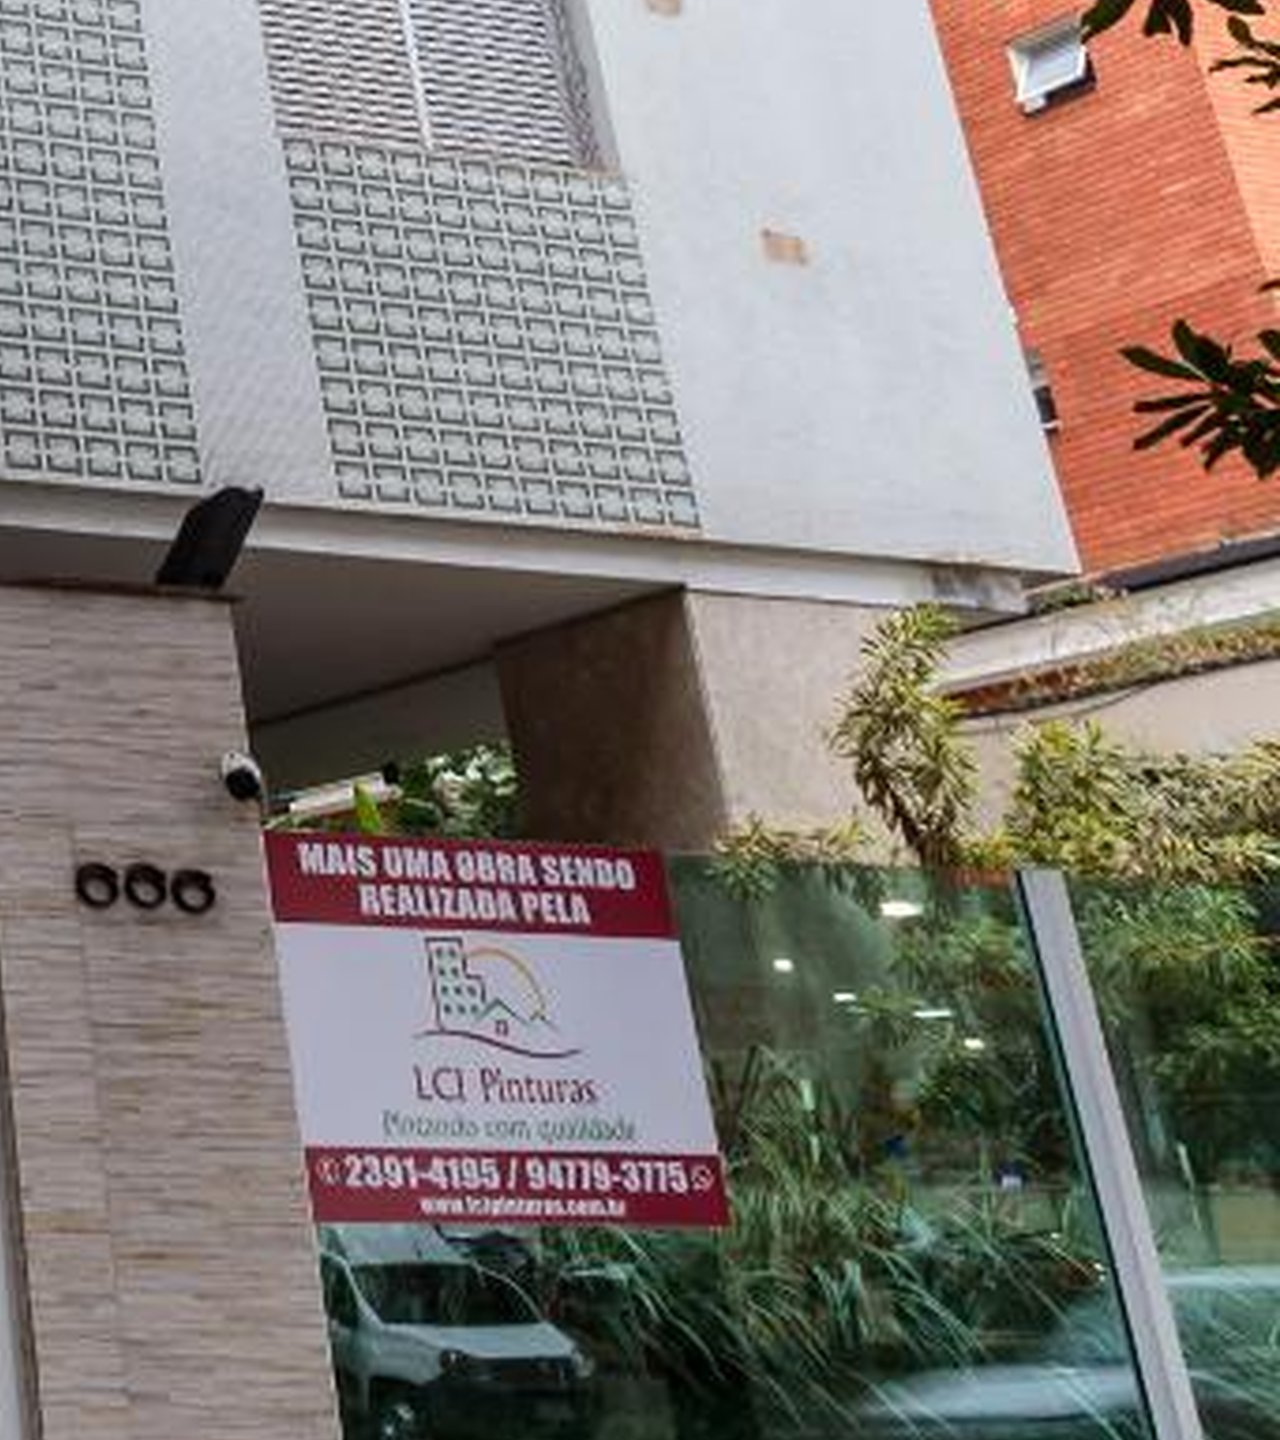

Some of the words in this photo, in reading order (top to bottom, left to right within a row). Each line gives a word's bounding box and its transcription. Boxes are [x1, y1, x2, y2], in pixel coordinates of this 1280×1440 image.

[297, 843, 377, 877] MAIS
[382, 847, 452, 882] UMA
[455, 850, 538, 886] OBRA
[543, 856, 636, 890] SENDO
[75, 862, 216, 915] 666
[360, 884, 520, 921] REALIZADA
[519, 891, 590, 925] PELA
[480, 1066, 600, 1104] Pinturas
[345, 1155, 500, 1190] 2391-4195
[526, 1158, 690, 1193] 94779-3775
